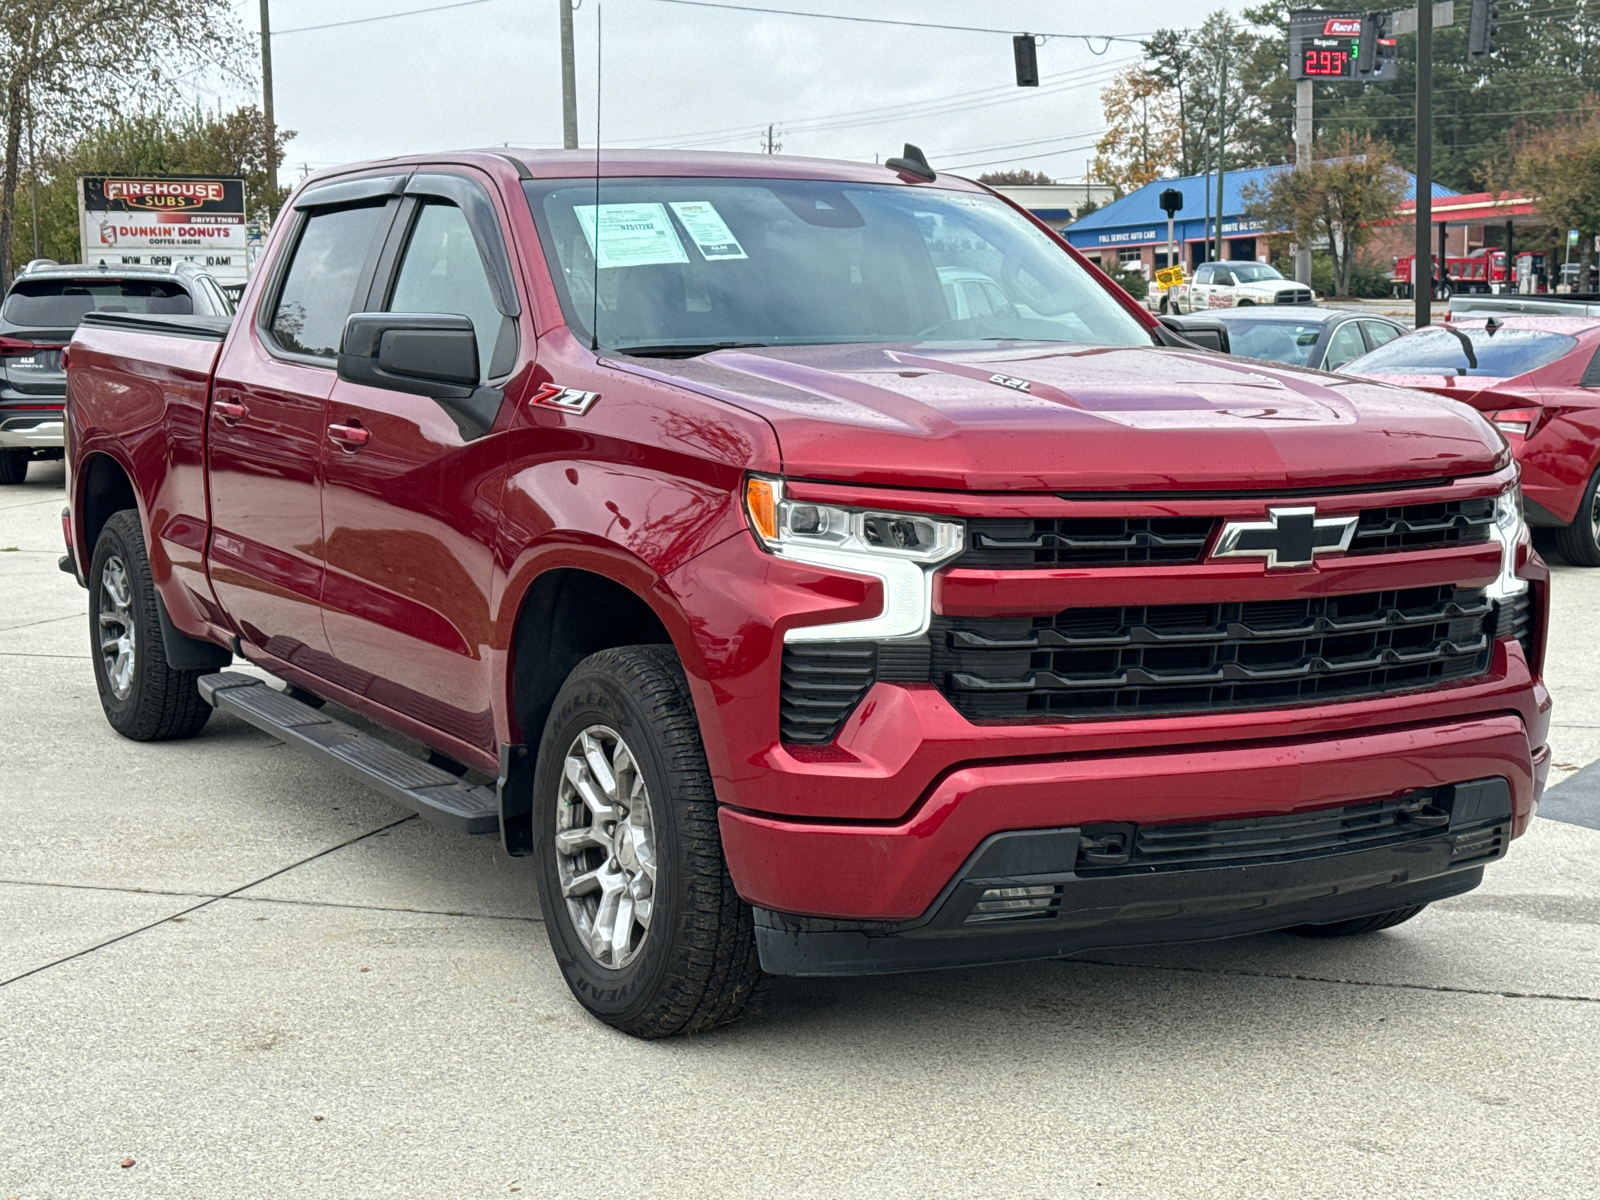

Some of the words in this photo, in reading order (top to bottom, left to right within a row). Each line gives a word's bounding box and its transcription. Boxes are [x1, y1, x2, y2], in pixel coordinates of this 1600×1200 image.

[1313, 38, 1338, 47] Regular
[108, 183, 220, 201] FIREHOUSE
[144, 195, 186, 206] SUBS
[216, 216, 240, 224] THRU
[119, 225, 176, 237] DUNKIN'
[177, 226, 231, 237] DONUTS
[1098, 234, 1110, 243] FULL
[1110, 232, 1130, 242] SERVICE
[1130, 231, 1143, 240] AUTO
[1143, 230, 1156, 239] CARE
[122, 255, 141, 266] NOW
[150, 255, 172, 266] OPEN
[528, 382, 601, 417] Z71
